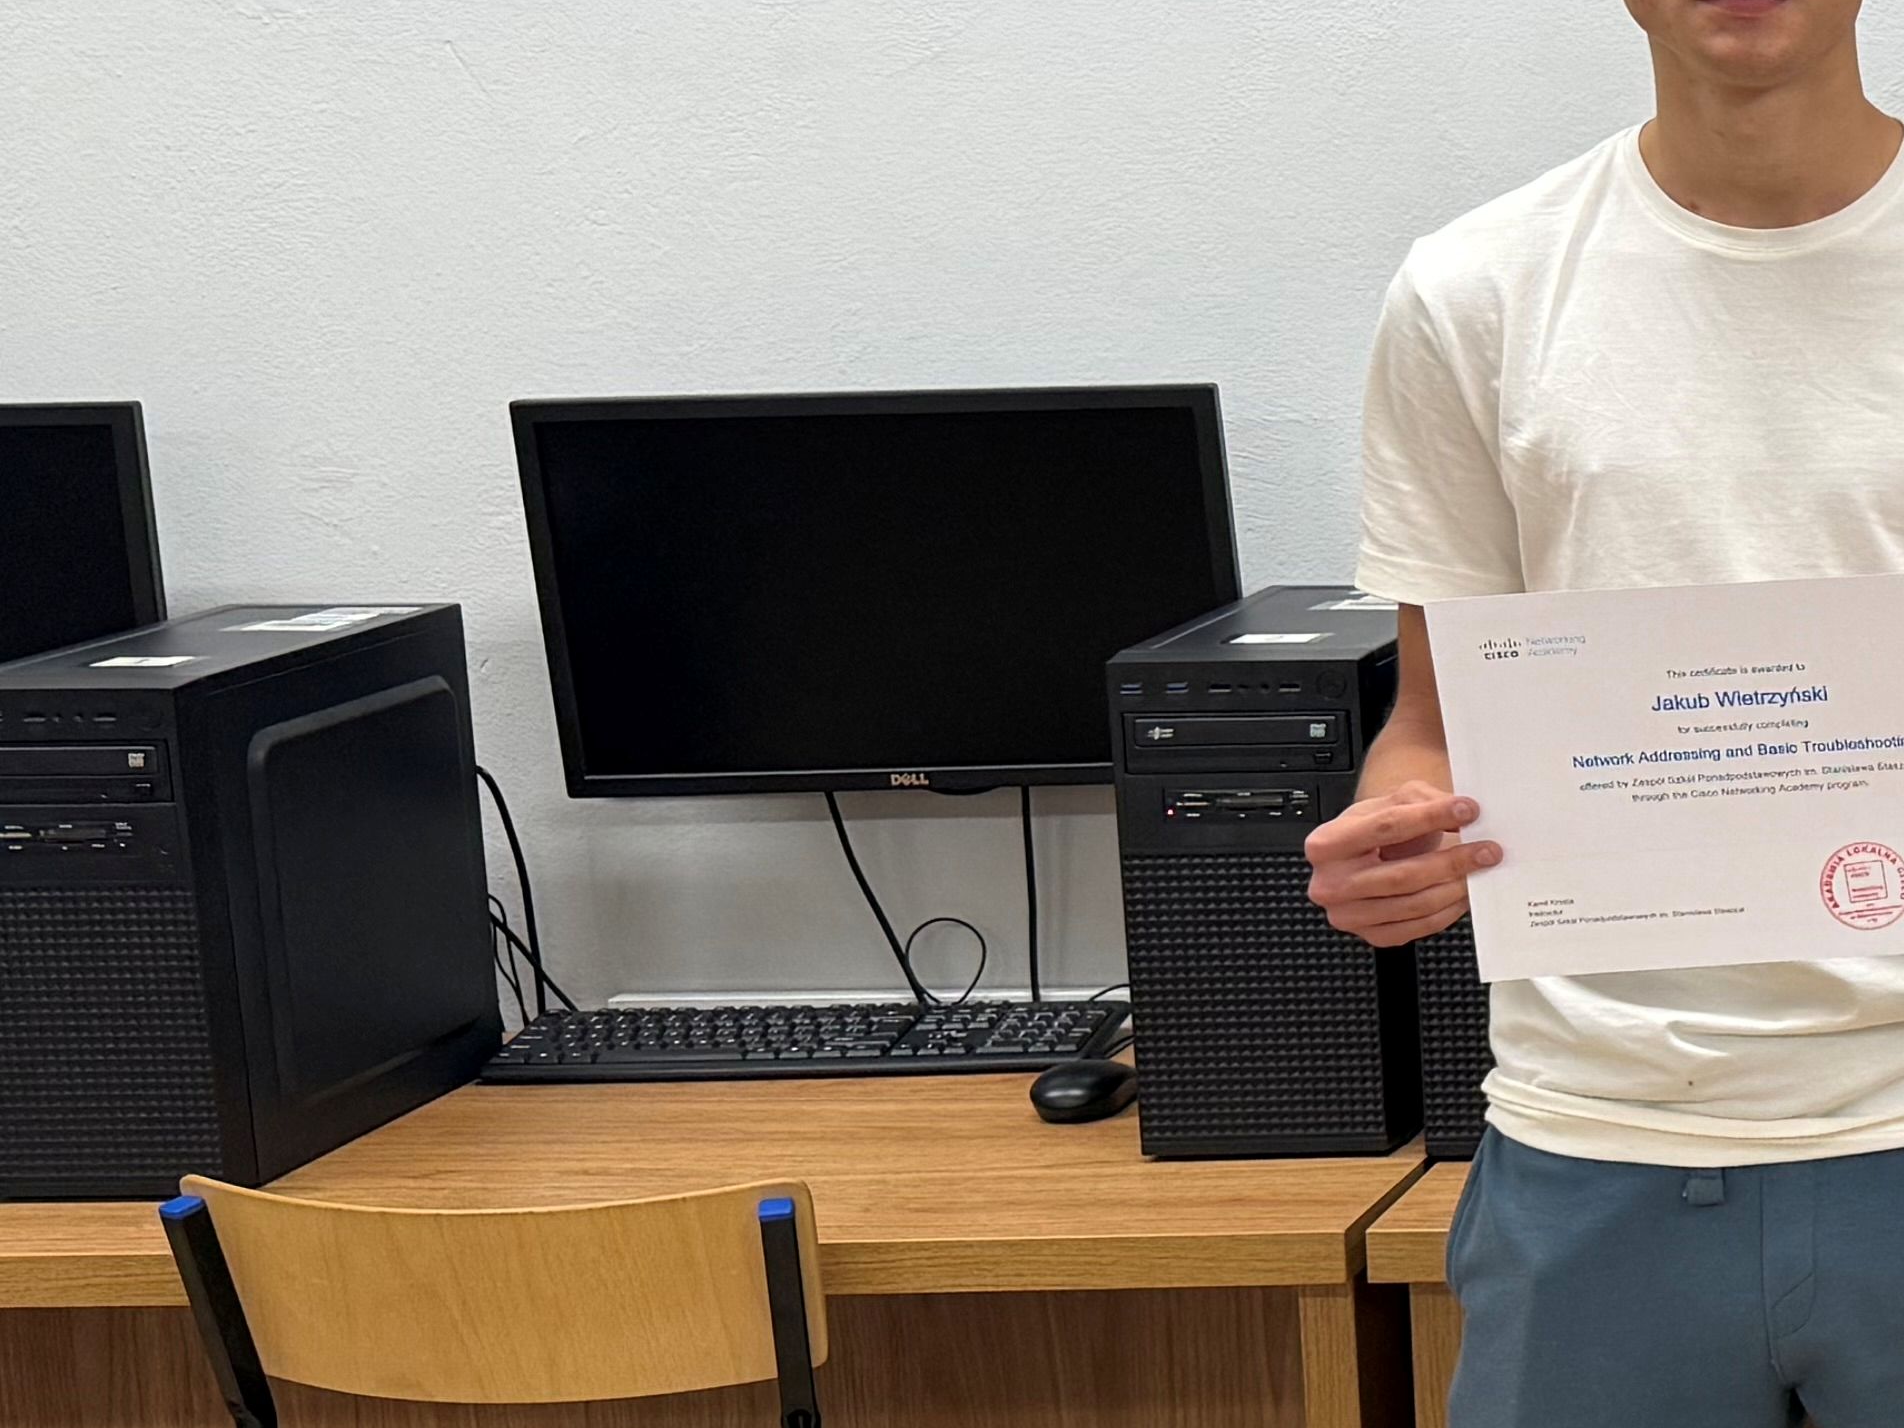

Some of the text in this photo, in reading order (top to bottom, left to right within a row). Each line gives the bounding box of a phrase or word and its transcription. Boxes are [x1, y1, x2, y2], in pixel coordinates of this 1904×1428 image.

[1652, 685, 1828, 711] Jakub Wietrzyński
[1572, 752, 1635, 769] Network
[1638, 747, 1721, 764] Addressing
[1725, 744, 1753, 759] and
[1757, 742, 1798, 756] Basic
[890, 773, 929, 786] DELL
